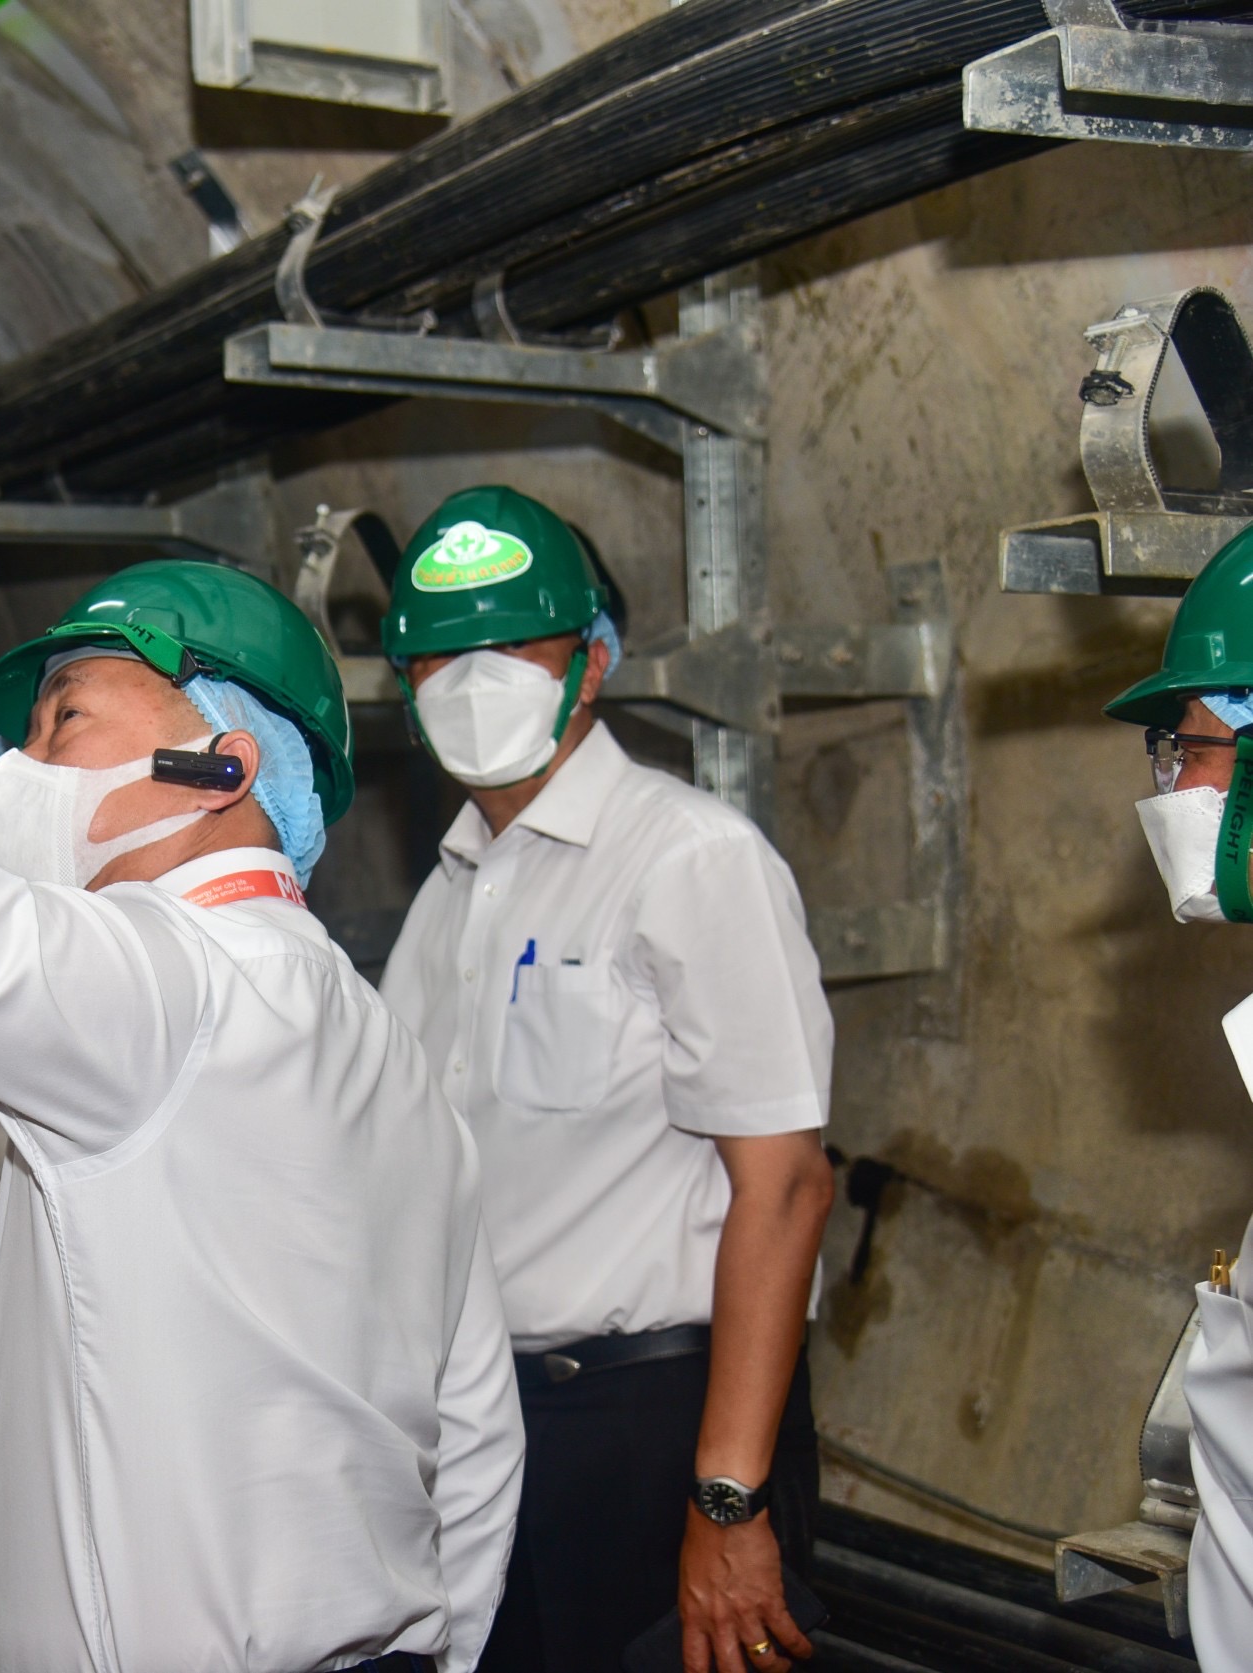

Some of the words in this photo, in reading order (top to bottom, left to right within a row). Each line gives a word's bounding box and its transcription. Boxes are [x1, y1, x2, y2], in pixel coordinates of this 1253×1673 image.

[224, 881, 236, 890] city
[220, 888, 237, 897] smart
[237, 885, 255, 893] living
